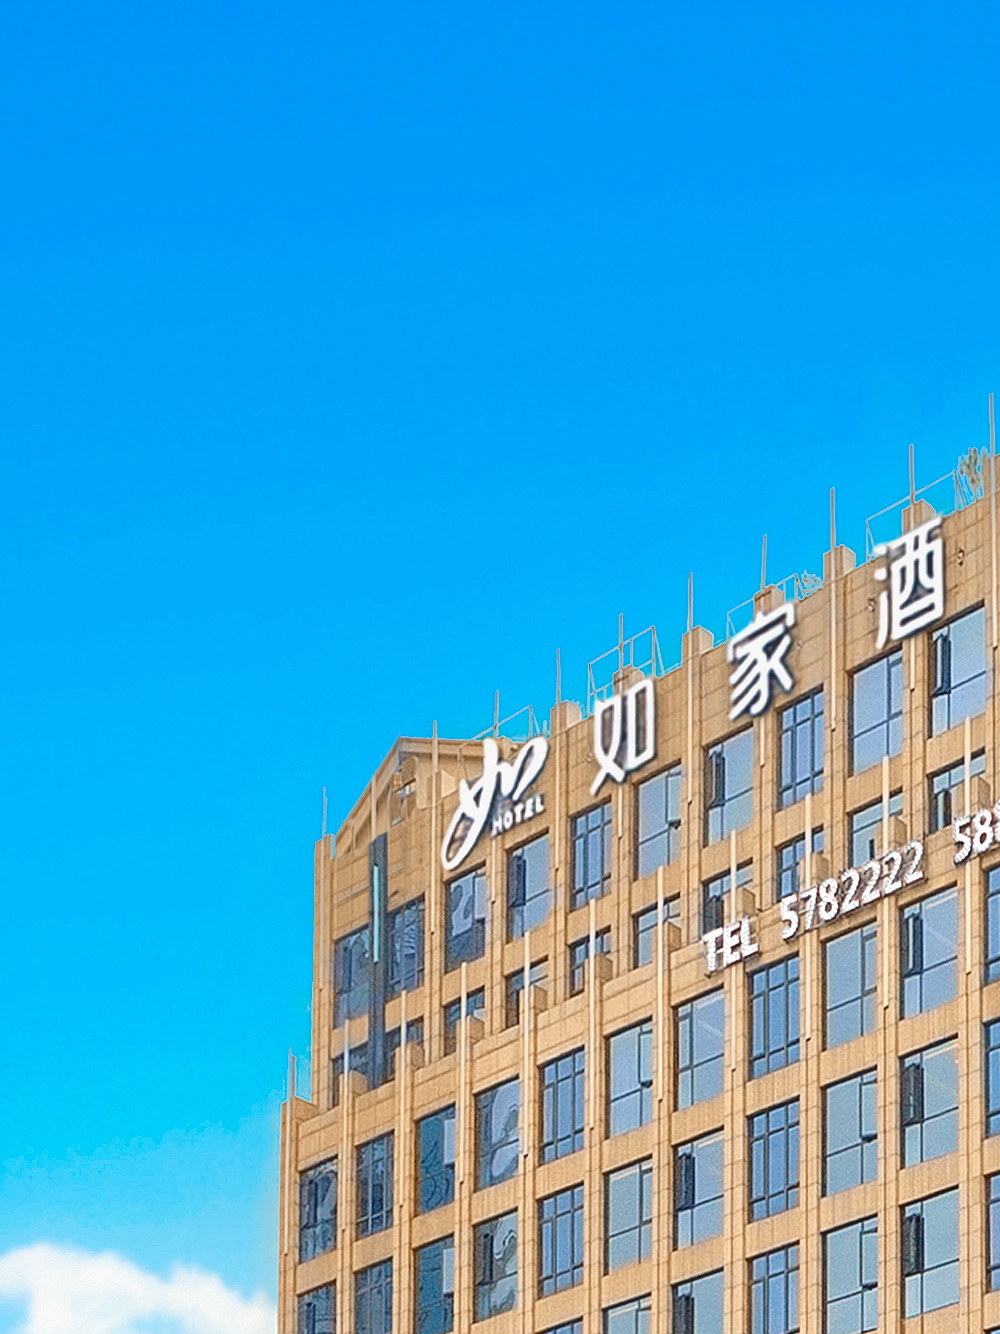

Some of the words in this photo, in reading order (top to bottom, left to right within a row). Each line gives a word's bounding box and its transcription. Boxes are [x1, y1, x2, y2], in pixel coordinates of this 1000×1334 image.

[489, 793, 545, 837] HOTEL
[701, 916, 760, 973] TEL
[779, 840, 925, 941] 5782222
